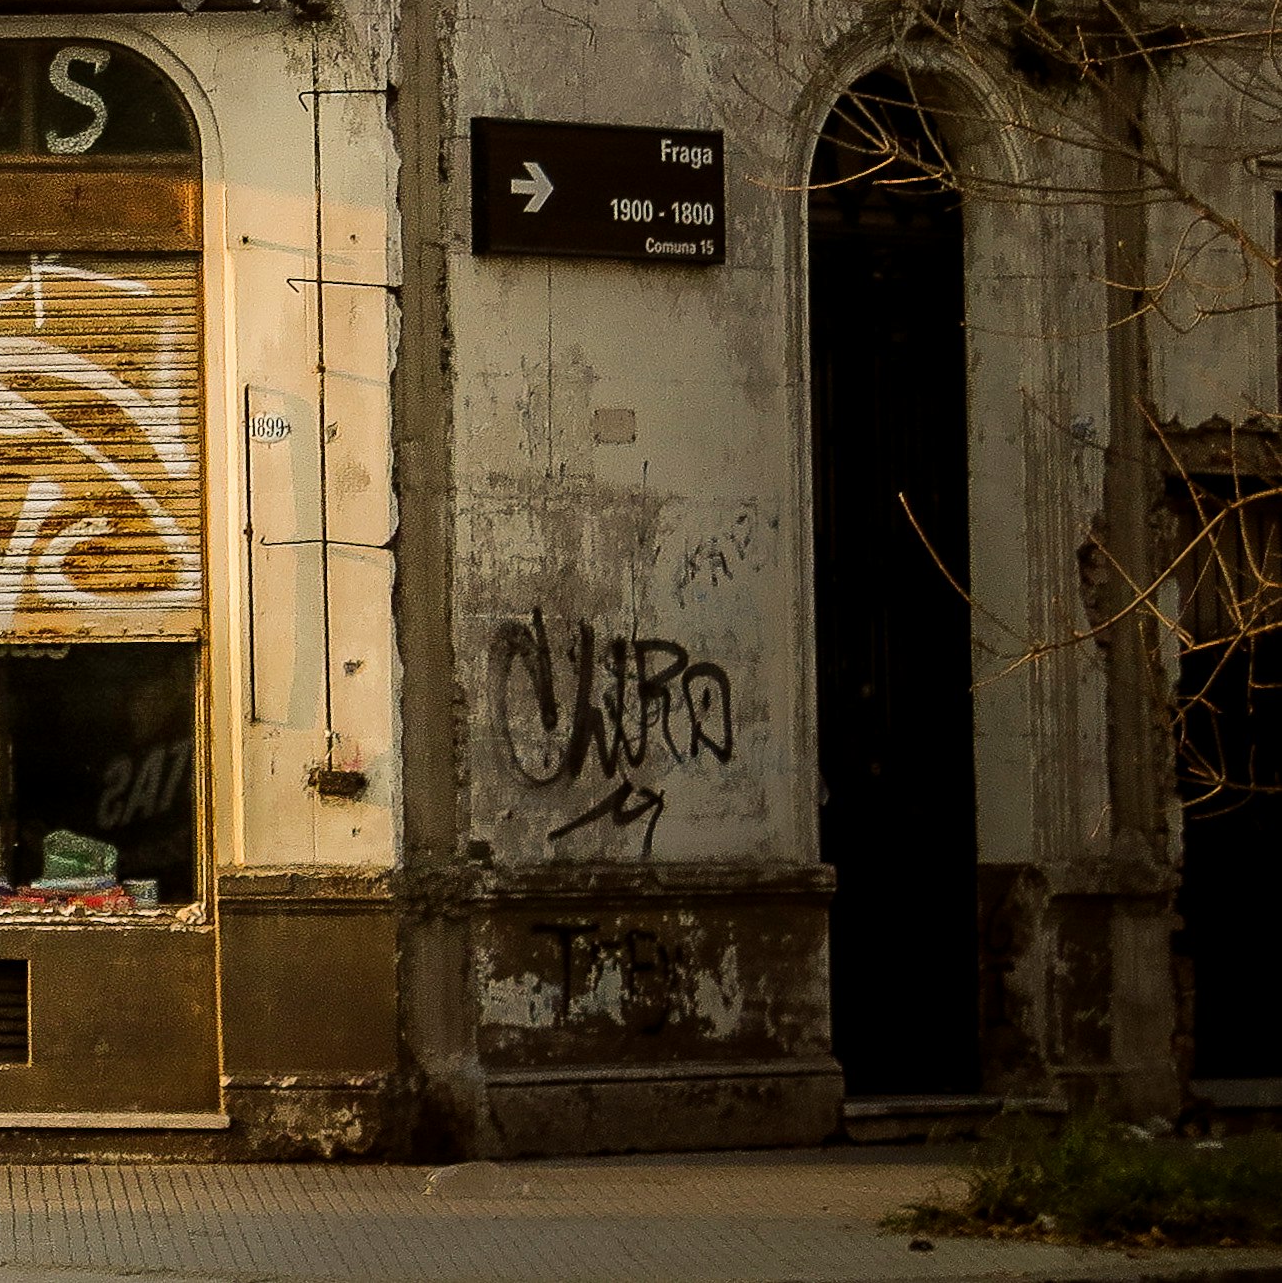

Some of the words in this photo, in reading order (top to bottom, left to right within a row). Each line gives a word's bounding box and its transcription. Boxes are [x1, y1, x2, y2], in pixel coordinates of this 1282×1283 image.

[660, 138, 714, 169] Fraga
[610, 198, 653, 222] 1900
[671, 201, 714, 226] 1800
[644, 236, 697, 255] Comuna
[698, 238, 715, 255] 15
[250, 416, 286, 438] 1899
